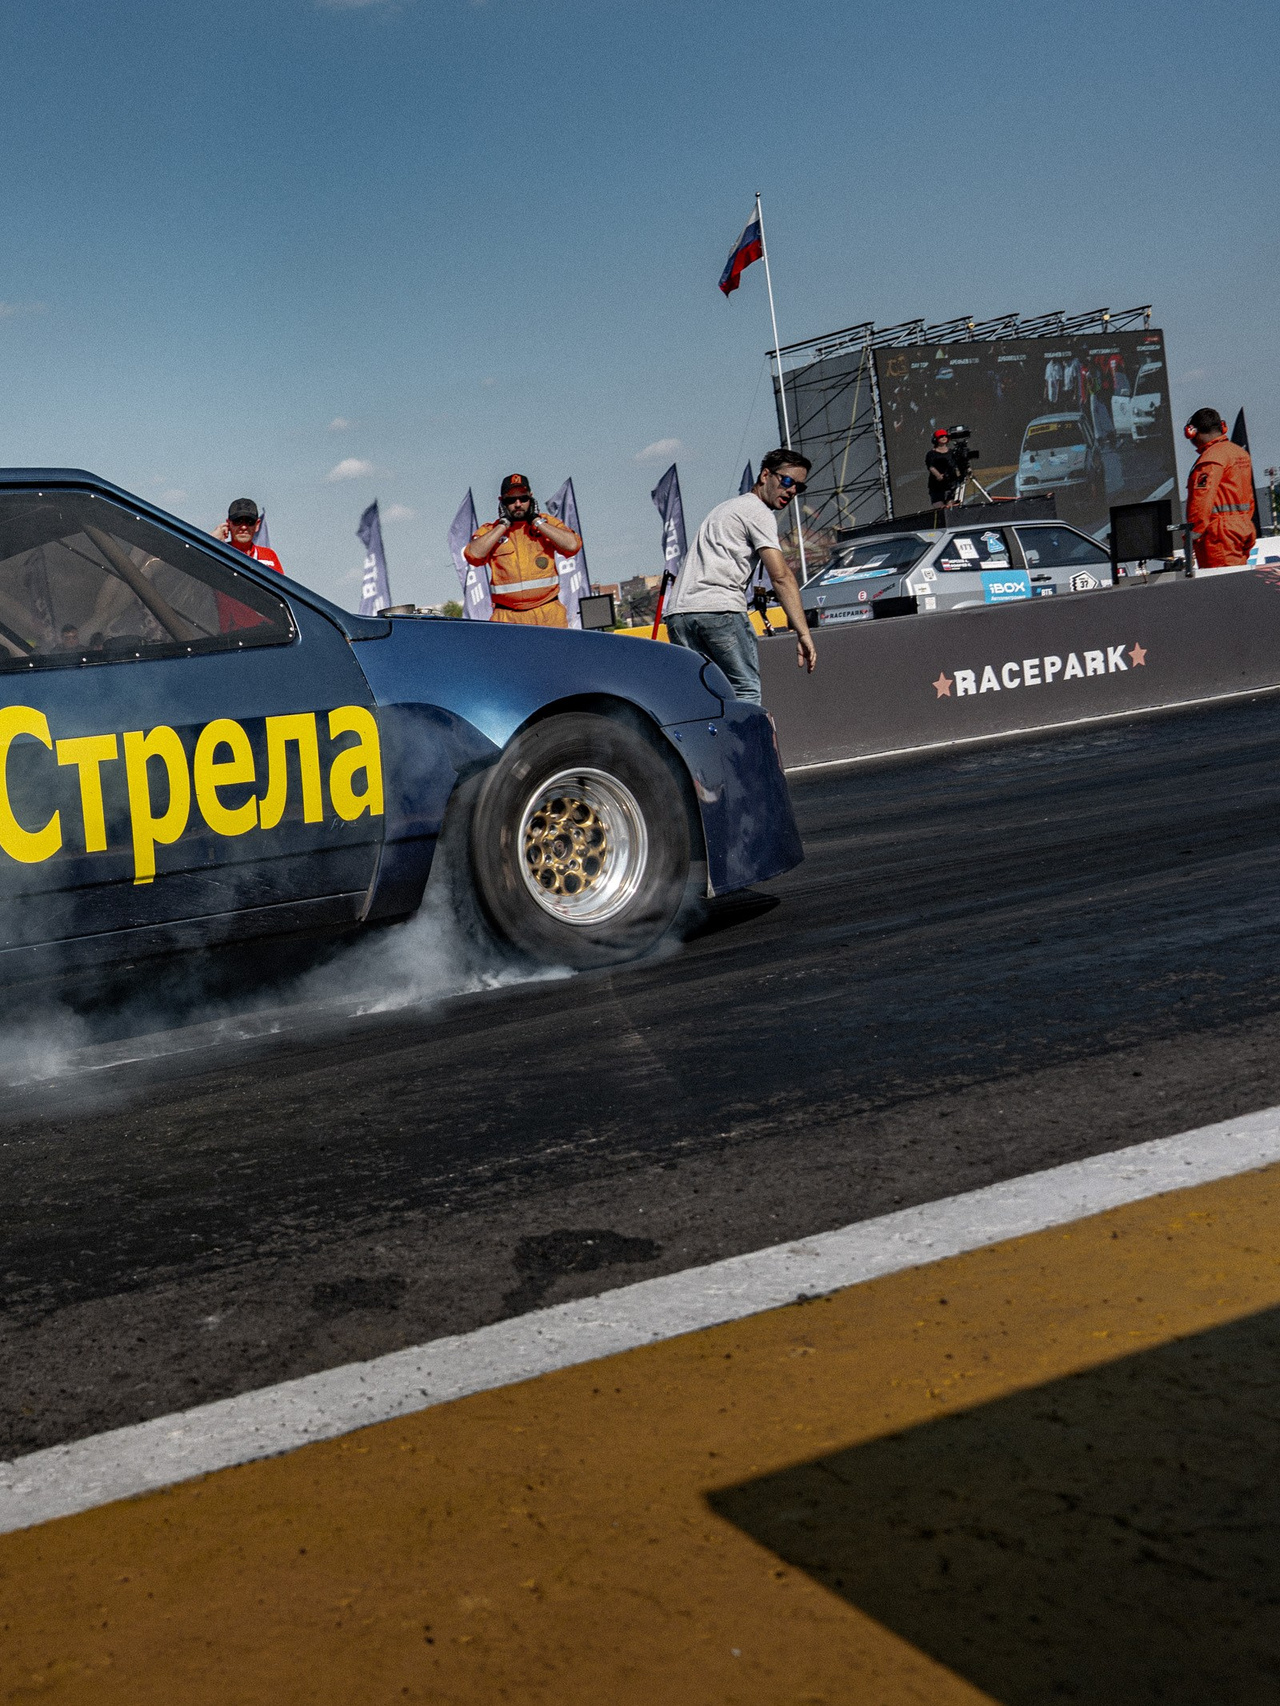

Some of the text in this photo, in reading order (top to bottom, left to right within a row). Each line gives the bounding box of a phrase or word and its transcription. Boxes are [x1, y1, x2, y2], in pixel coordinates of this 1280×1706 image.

[988, 581, 1026, 595] iBOX
[829, 609, 864, 620] RACEPARK
[954, 644, 1128, 697] RACEPARK
